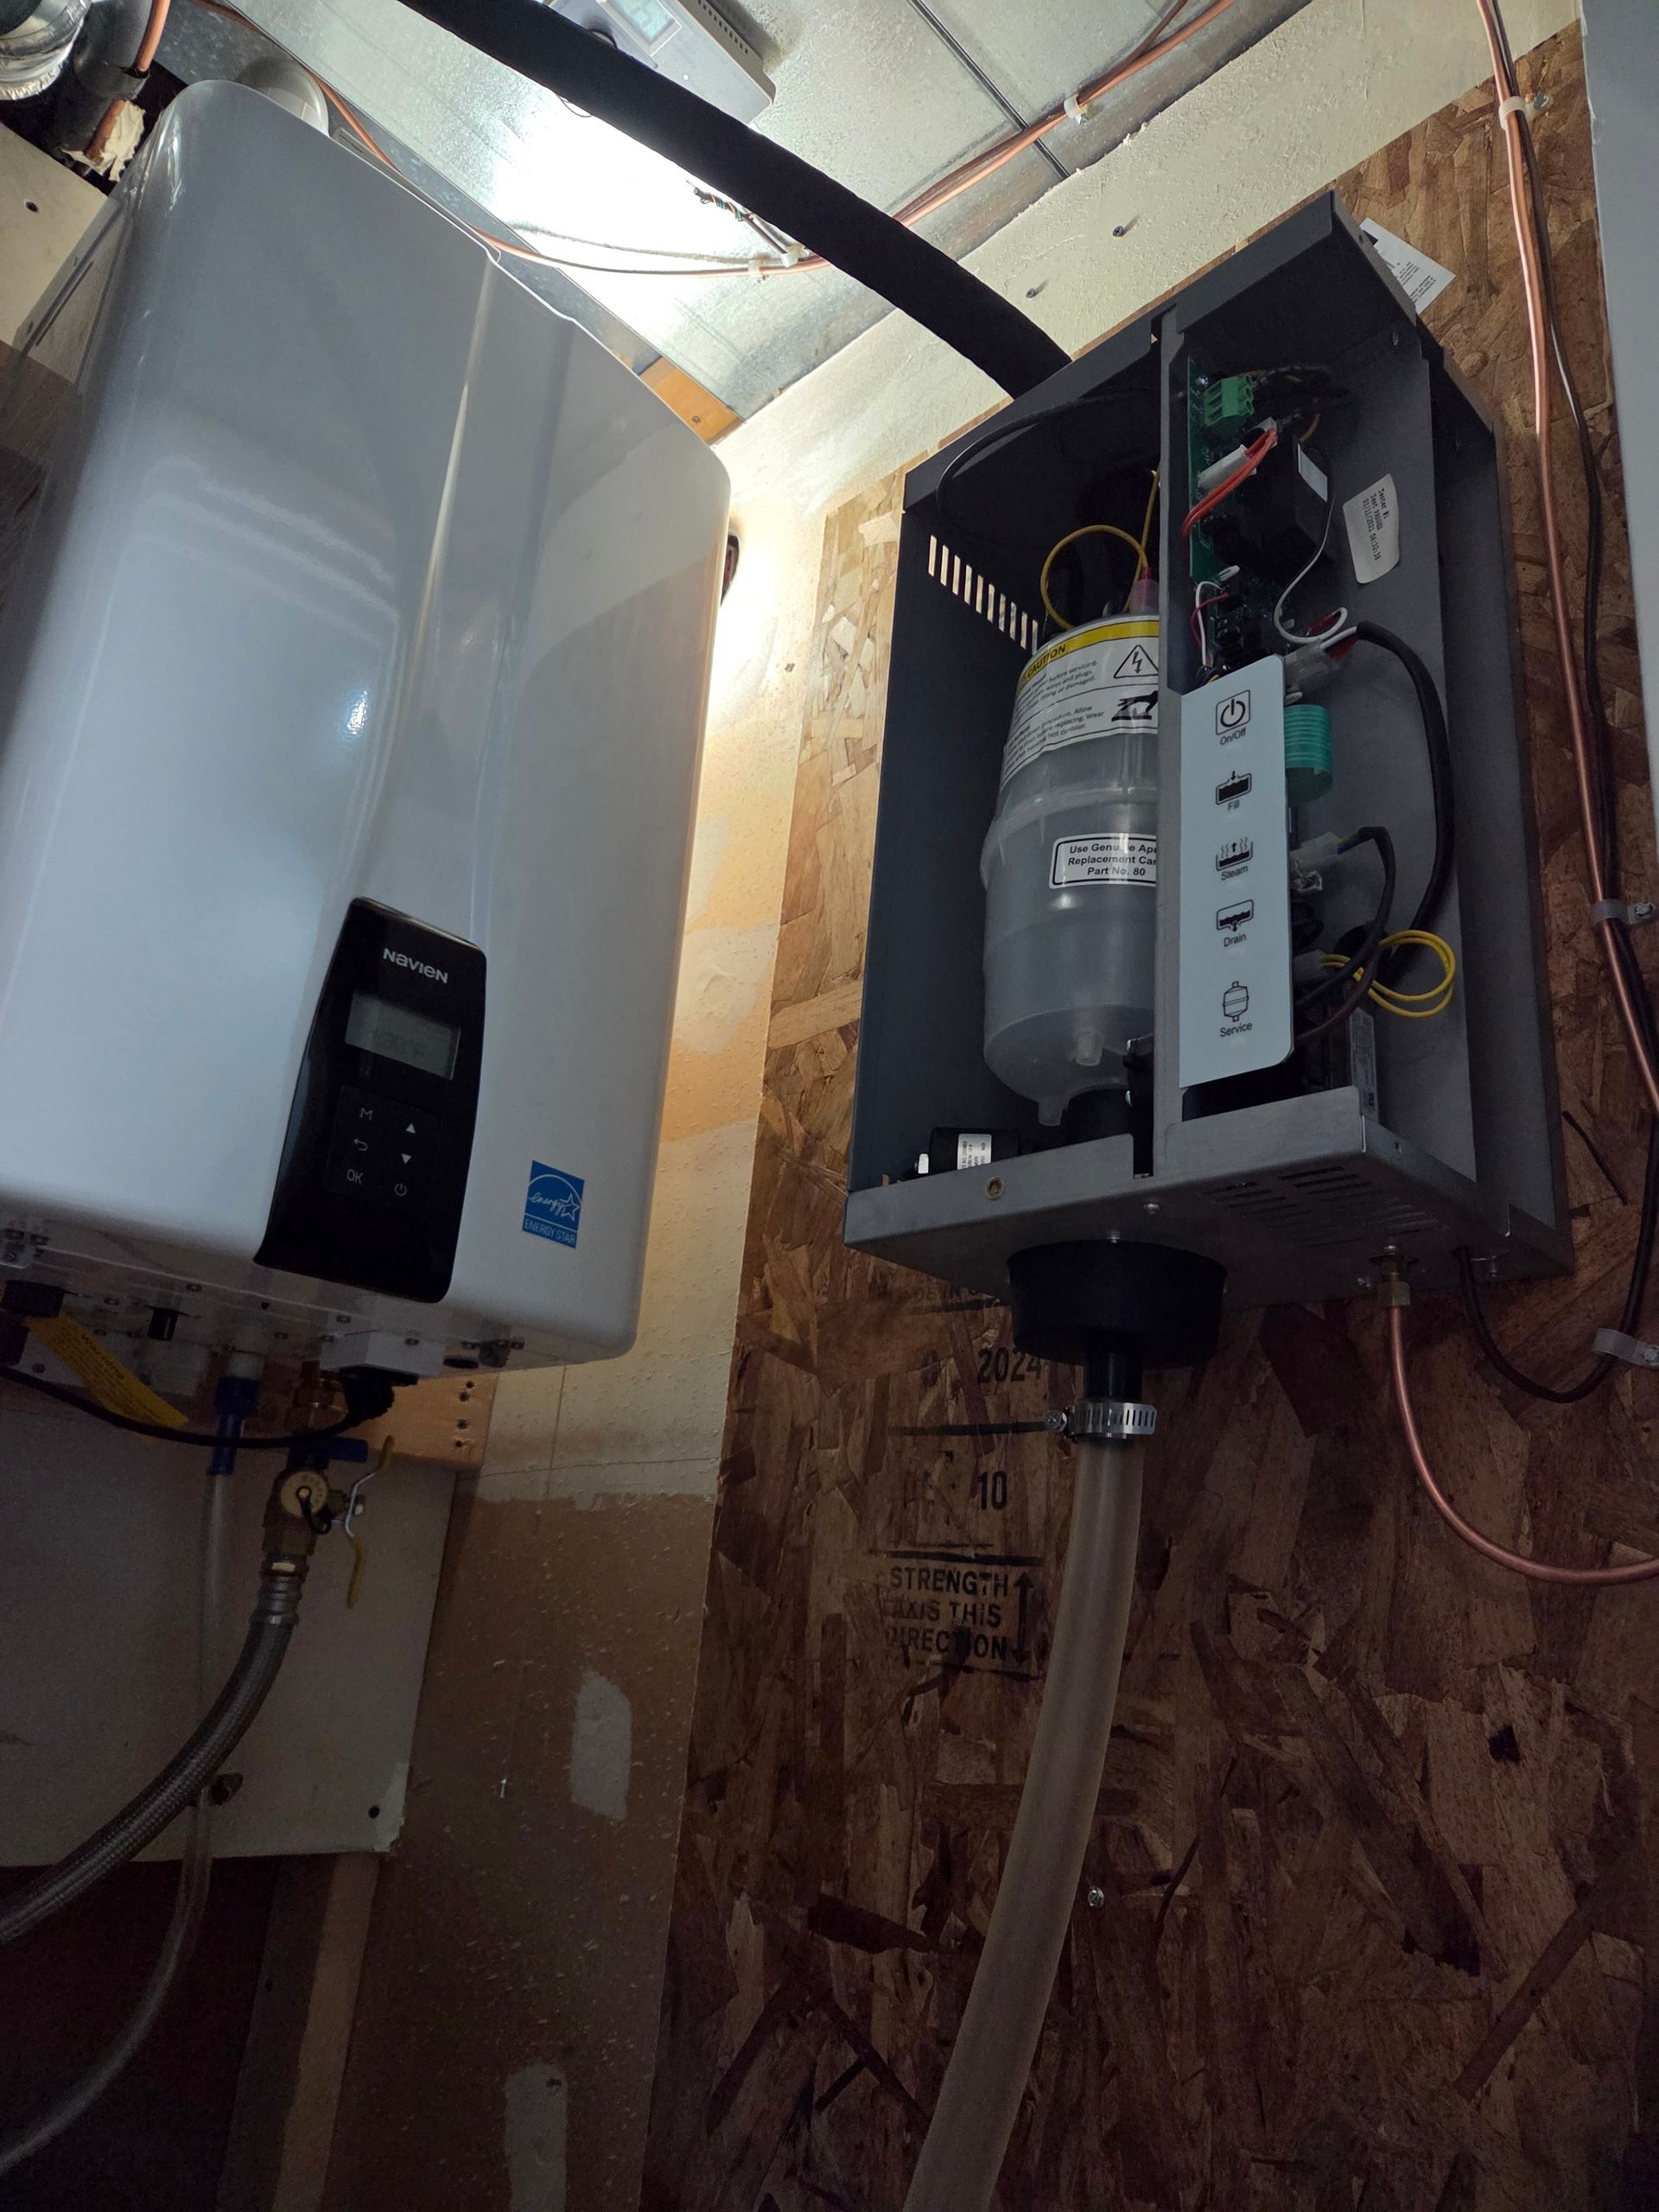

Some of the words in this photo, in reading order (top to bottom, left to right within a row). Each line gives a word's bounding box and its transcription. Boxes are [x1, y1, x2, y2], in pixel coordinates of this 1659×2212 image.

[1027, 644, 1066, 678] CAUTION
[1063, 676, 1073, 685] and
[1073, 706, 1092, 715] Allow
[1086, 711, 1105, 720] Wear
[1219, 729, 1247, 747] On/Off
[1227, 801, 1240, 812] Fill
[1070, 845, 1089, 855] Use
[1091, 843, 1135, 852] Genue
[1068, 855, 1135, 866] Replacement
[1087, 867, 1109, 875] Part
[1132, 868, 1146, 876] 80
[1221, 864, 1249, 881] Steam
[1223, 931, 1247, 947] Drain
[1219, 1021, 1253, 1038] Service
[359, 1107, 373, 1121] M
[346, 1168, 365, 1185] OK
[524, 1218, 556, 1236] ENERGY
[556, 1230, 575, 1245] STAR
[977, 1346, 1044, 1384] 2024
[978, 1471, 1007, 1510] 10
[889, 1566, 1009, 1598] STRENGTH
[950, 1600, 1001, 1628] THIS
